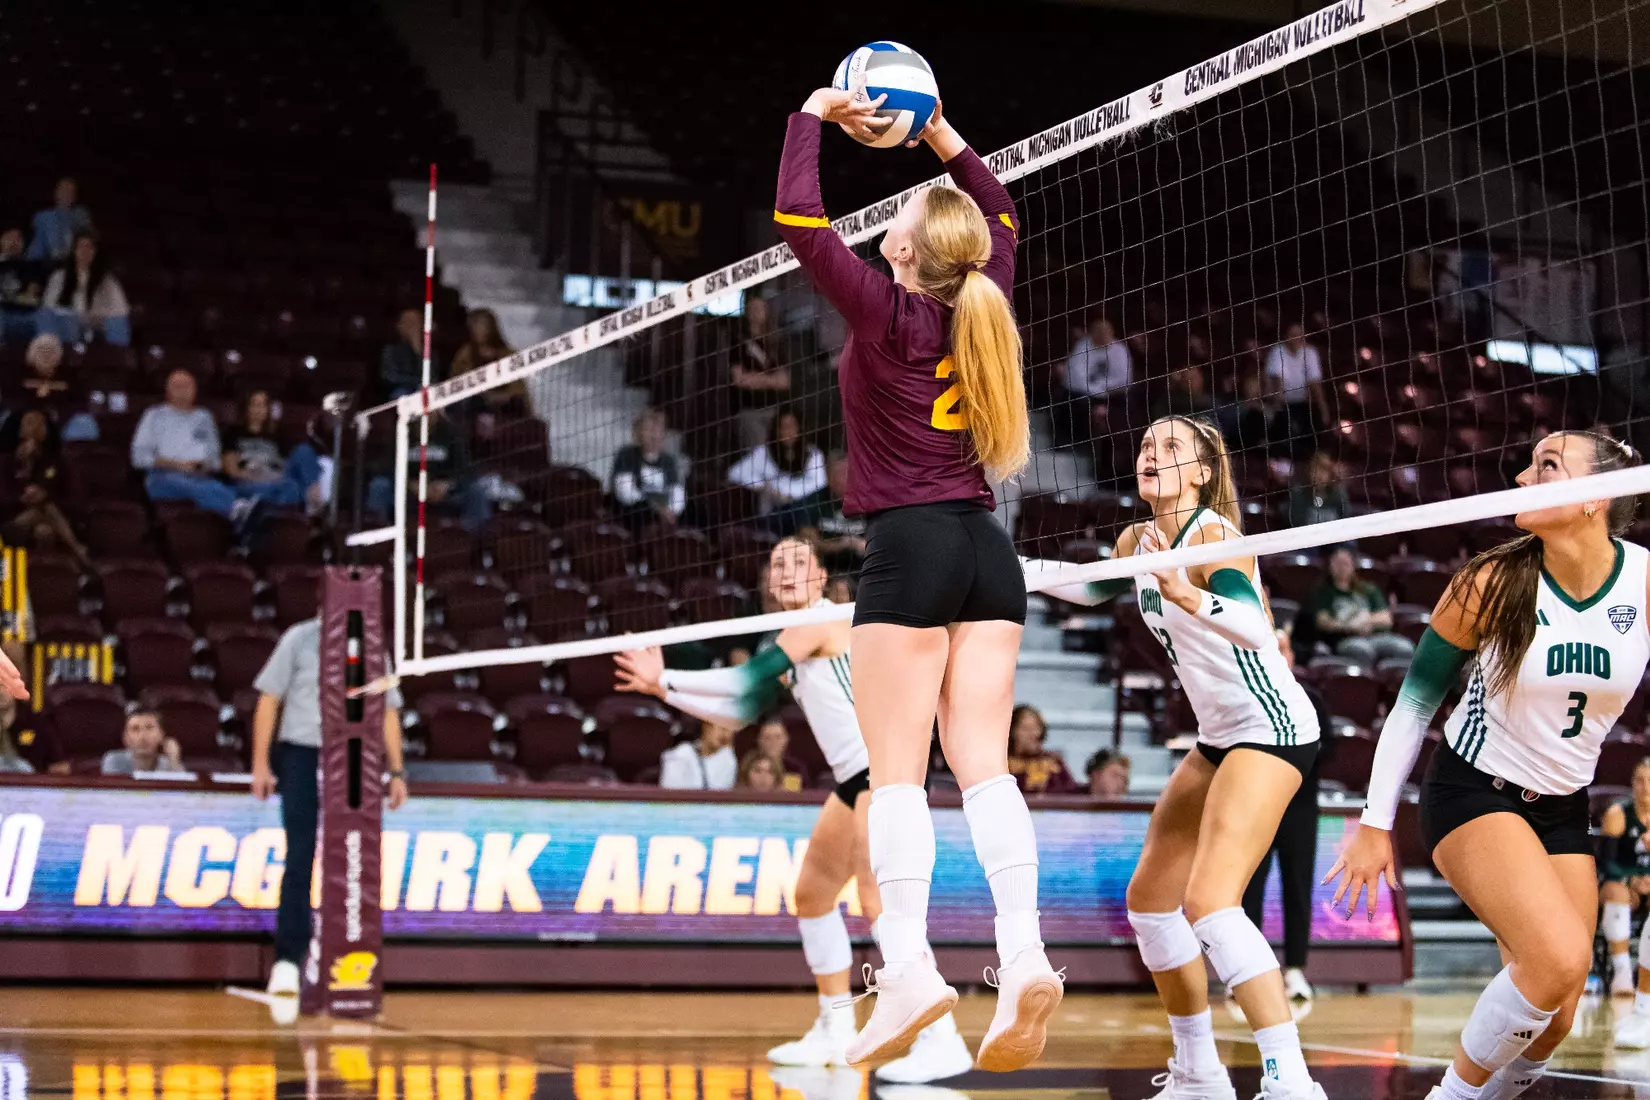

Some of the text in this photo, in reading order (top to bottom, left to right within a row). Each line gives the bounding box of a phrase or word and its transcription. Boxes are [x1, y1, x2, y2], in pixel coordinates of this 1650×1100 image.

[1184, 0, 1366, 96] CENTRAL MICHIGAN VOLLEYBALL
[988, 96, 1131, 176] CENTRAL MICHIGAN VOLLEYBALL
[930, 355, 970, 431] 2
[1140, 587, 1164, 617] OHIO
[1546, 642, 1611, 680] OHIO
[1561, 691, 1588, 738] 3
[74, 824, 551, 913] MCGIRK
